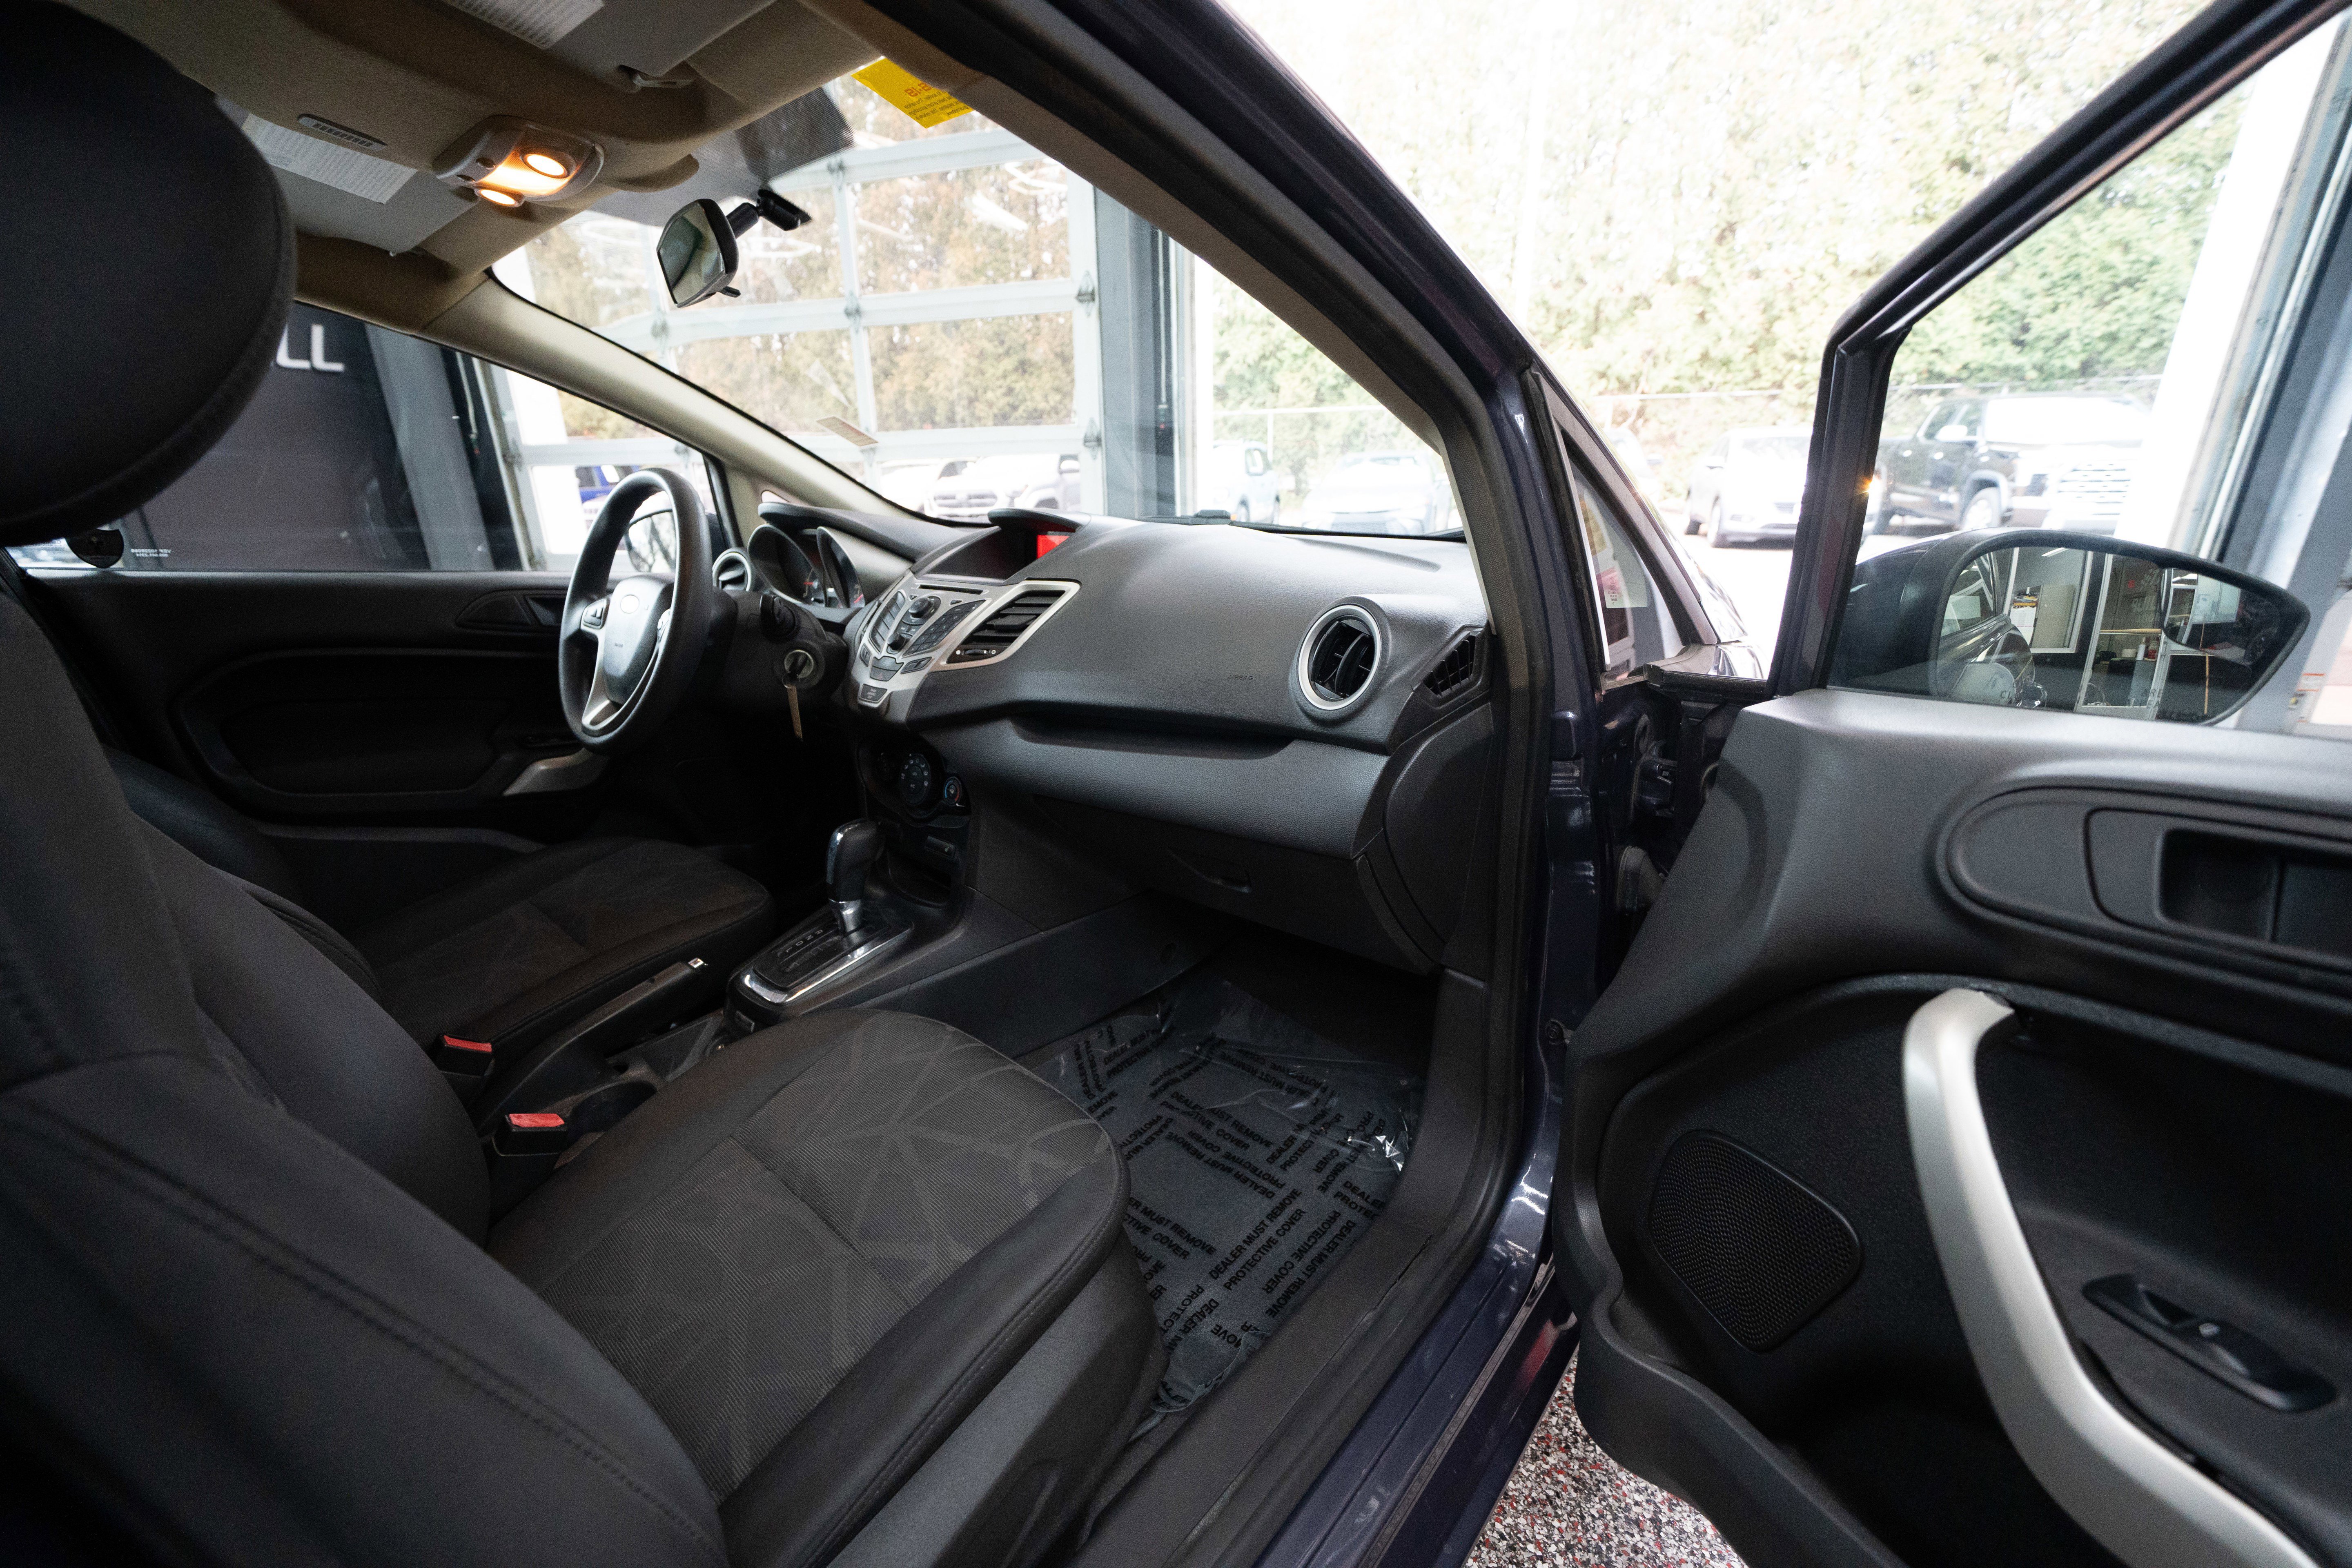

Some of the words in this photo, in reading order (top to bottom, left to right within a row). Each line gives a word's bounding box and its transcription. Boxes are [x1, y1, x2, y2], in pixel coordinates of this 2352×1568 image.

[1084, 1040, 1107, 1093] PROTECTIV
[1087, 1090, 1119, 1114] EMOVE
[1141, 1118, 1174, 1146] DEALER
[1165, 1131, 1205, 1160] REMOVE
[1188, 1129, 1221, 1153] COVER
[1216, 1128, 1250, 1151] COVER
[1230, 1118, 1274, 1149] REMOVE
[1203, 1156, 1234, 1174] MUST
[1266, 1135, 1297, 1164] DEALER
[1221, 1151, 1286, 1189] PROTECTIVE
[1234, 1170, 1276, 1200] DEALER
[1141, 1206, 1172, 1227] MUST
[1170, 1223, 1217, 1256] REMOVE
[1152, 1232, 1190, 1260] COVER
[1208, 1244, 1247, 1281] DEALER
[1242, 1219, 1270, 1247] MUST
[1265, 1188, 1303, 1223] REMOVE
[1290, 1210, 1341, 1262] PROTECTIVE
[1323, 1219, 1357, 1254] DEALER
[1223, 1235, 1279, 1291] PROTECTIVE
[1275, 1208, 1307, 1237] COVER
[1303, 1251, 1329, 1279] MUST
[1261, 1260, 1295, 1295] COVER
[1160, 1284, 1205, 1336] PROTECT
[1265, 1276, 1307, 1319] REMOVE
[1178, 1298, 1220, 1335] DEALER
